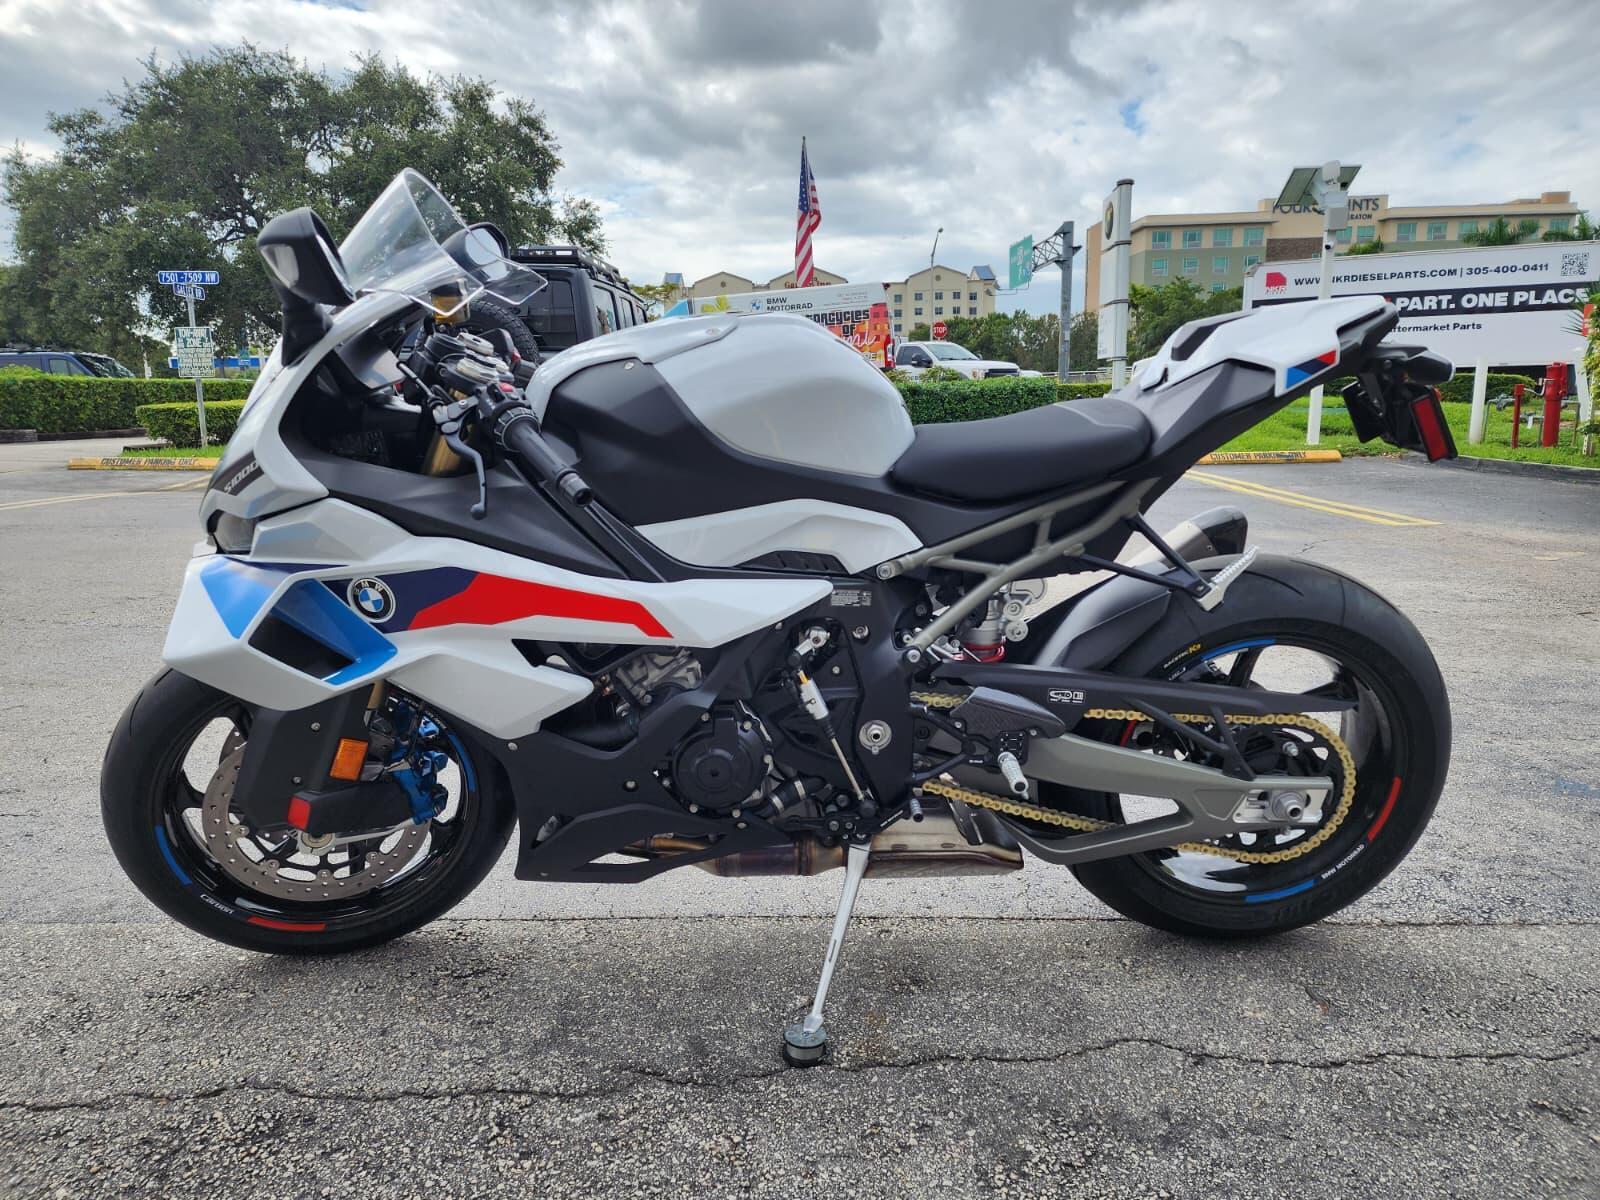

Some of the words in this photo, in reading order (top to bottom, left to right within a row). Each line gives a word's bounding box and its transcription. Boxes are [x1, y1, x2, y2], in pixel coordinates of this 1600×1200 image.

[1466, 263, 1549, 276] 305-400-0411
[205, 272, 217, 283] NW
[1395, 295, 1455, 311] PART.
[1461, 292, 1508, 308] ONE
[1513, 288, 1590, 306] PLACE
[766, 302, 813, 311] MOTORRAD
[933, 326, 947, 334] STOP
[1453, 322, 1482, 331] Parts
[101, 457, 141, 465] CUSTOMER
[144, 457, 176, 466] PARKING
[1321, 867, 1336, 879] BMW
